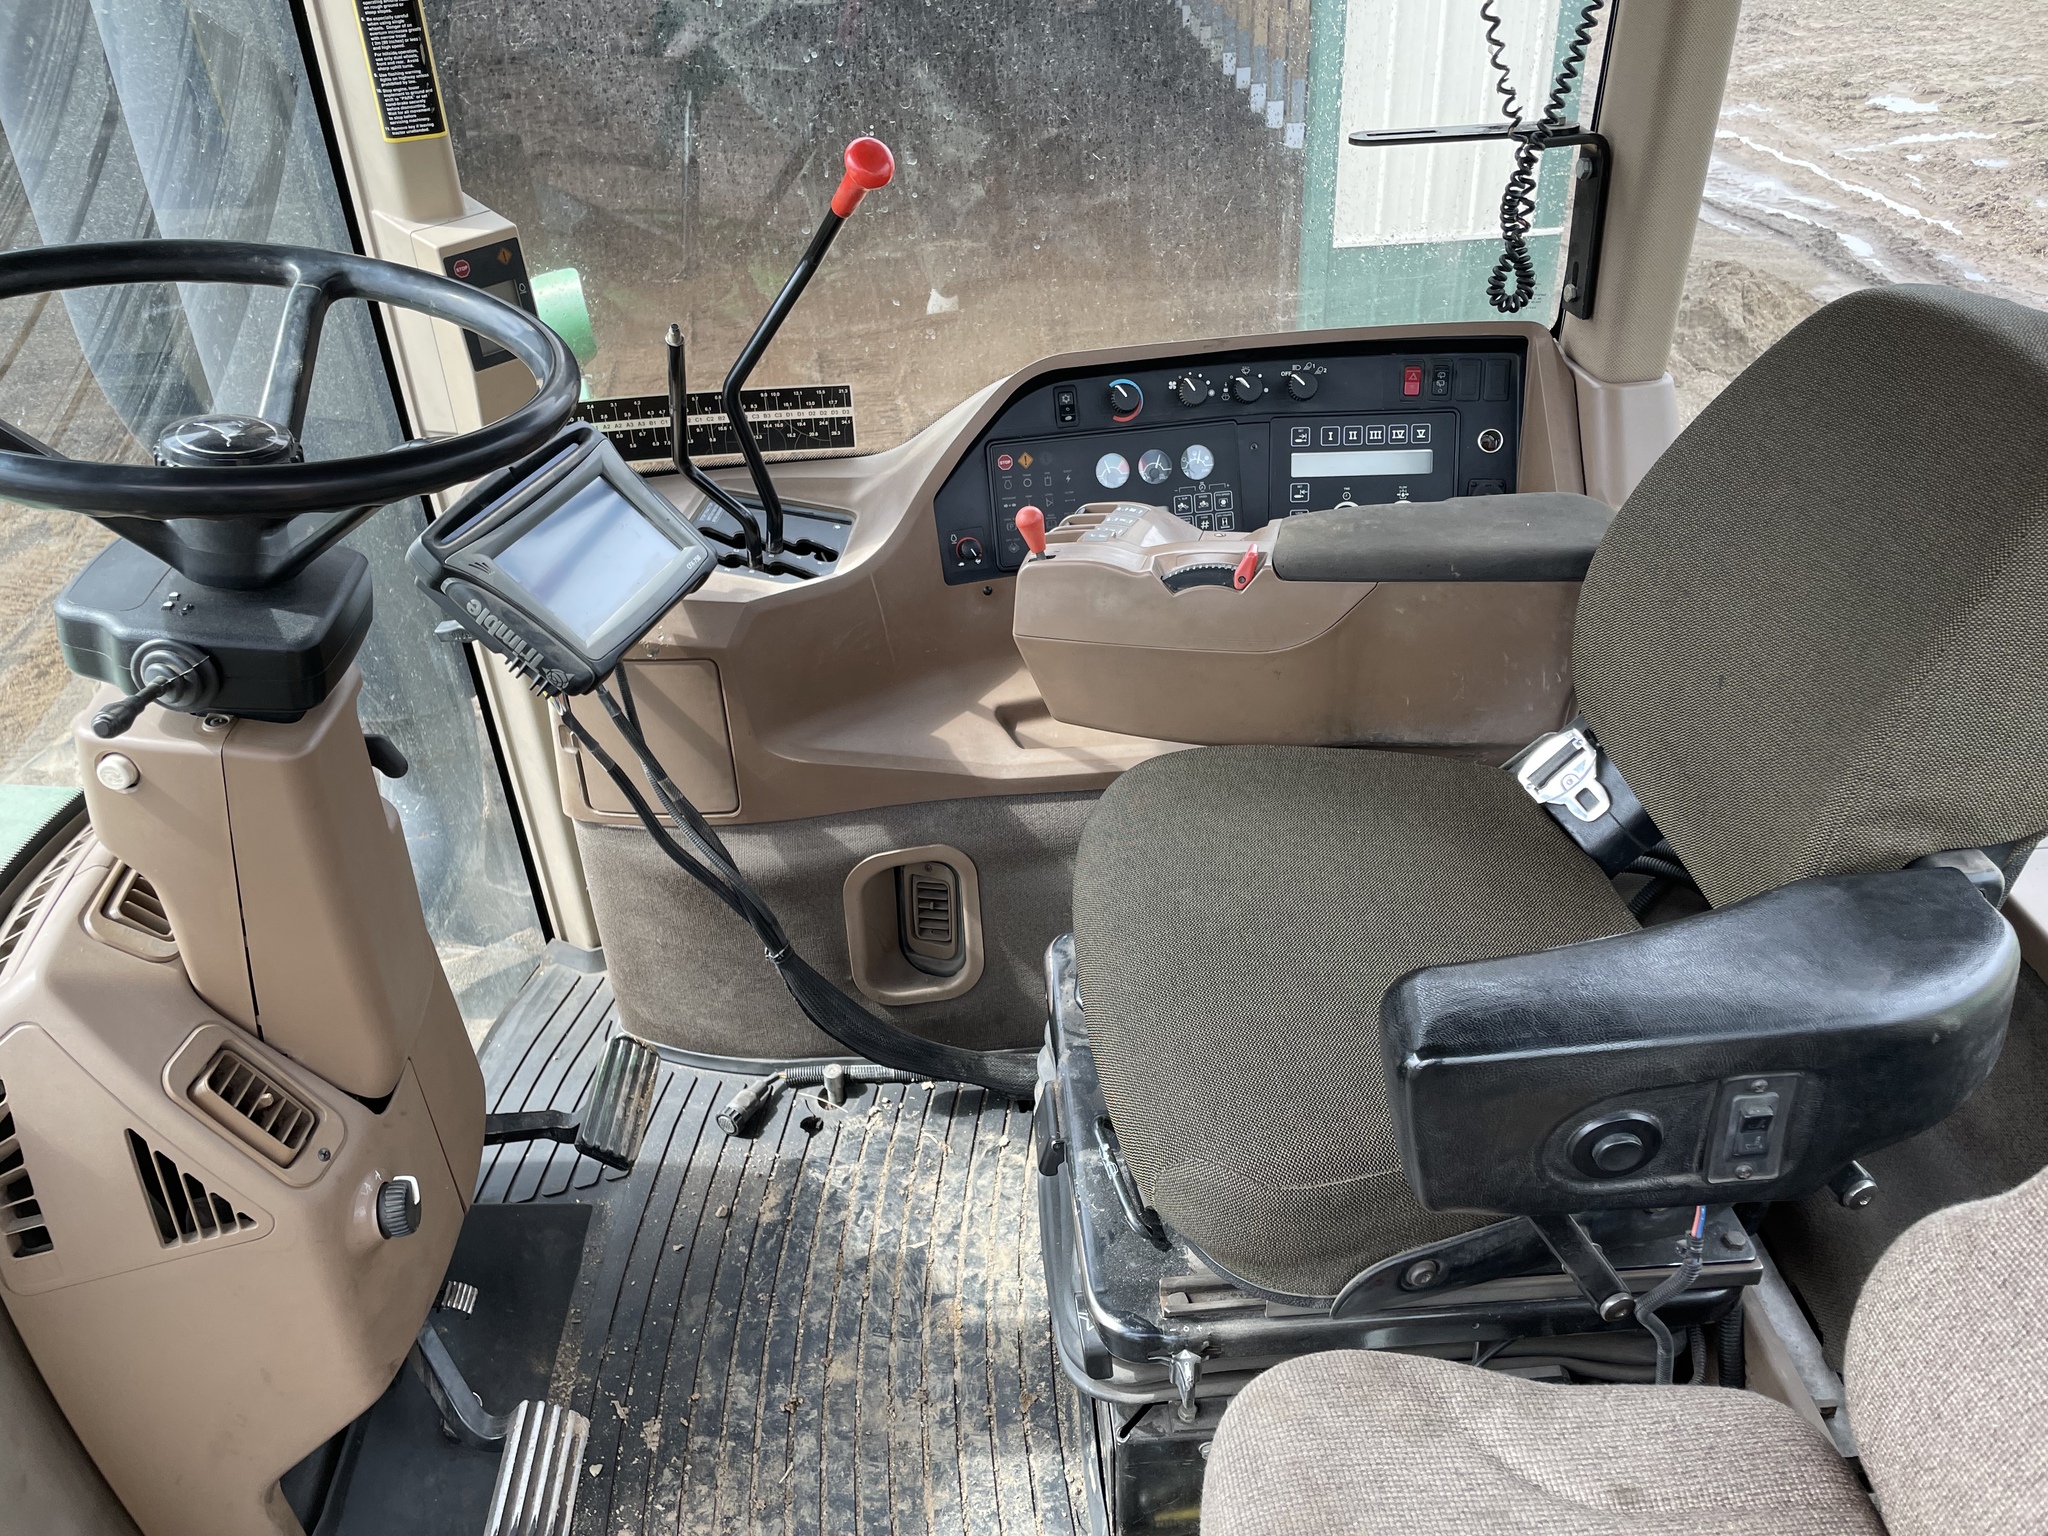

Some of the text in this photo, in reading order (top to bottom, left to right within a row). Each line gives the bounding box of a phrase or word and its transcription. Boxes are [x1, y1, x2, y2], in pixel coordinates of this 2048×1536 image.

[1328, 432, 1333, 441] I
[1349, 431, 1357, 440] II
[1369, 430, 1381, 439] III
[1392, 430, 1405, 438] IV
[1417, 429, 1426, 438] V
